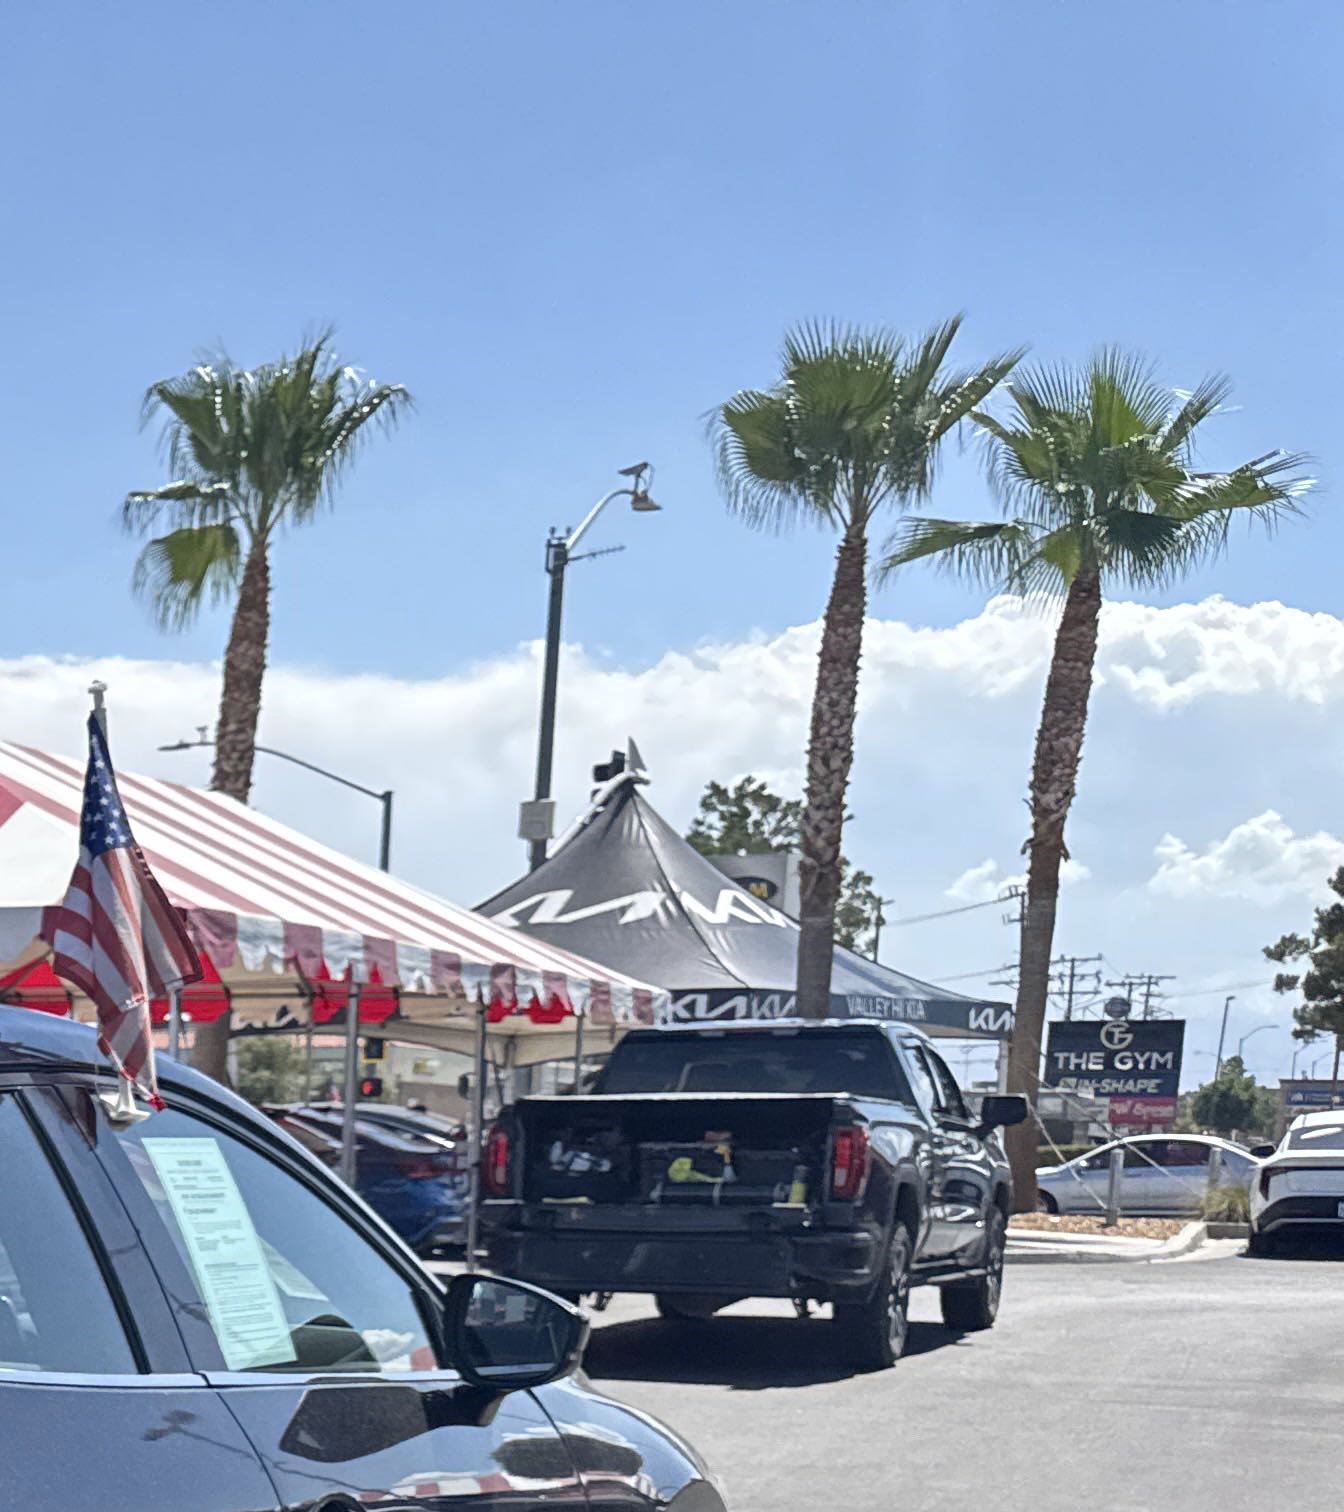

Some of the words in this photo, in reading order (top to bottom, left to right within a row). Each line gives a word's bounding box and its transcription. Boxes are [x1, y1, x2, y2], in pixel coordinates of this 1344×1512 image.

[845, 993, 890, 1017] VALLEY
[1053, 1052, 1105, 1070] THE
[1114, 1051, 1174, 1070] GYM
